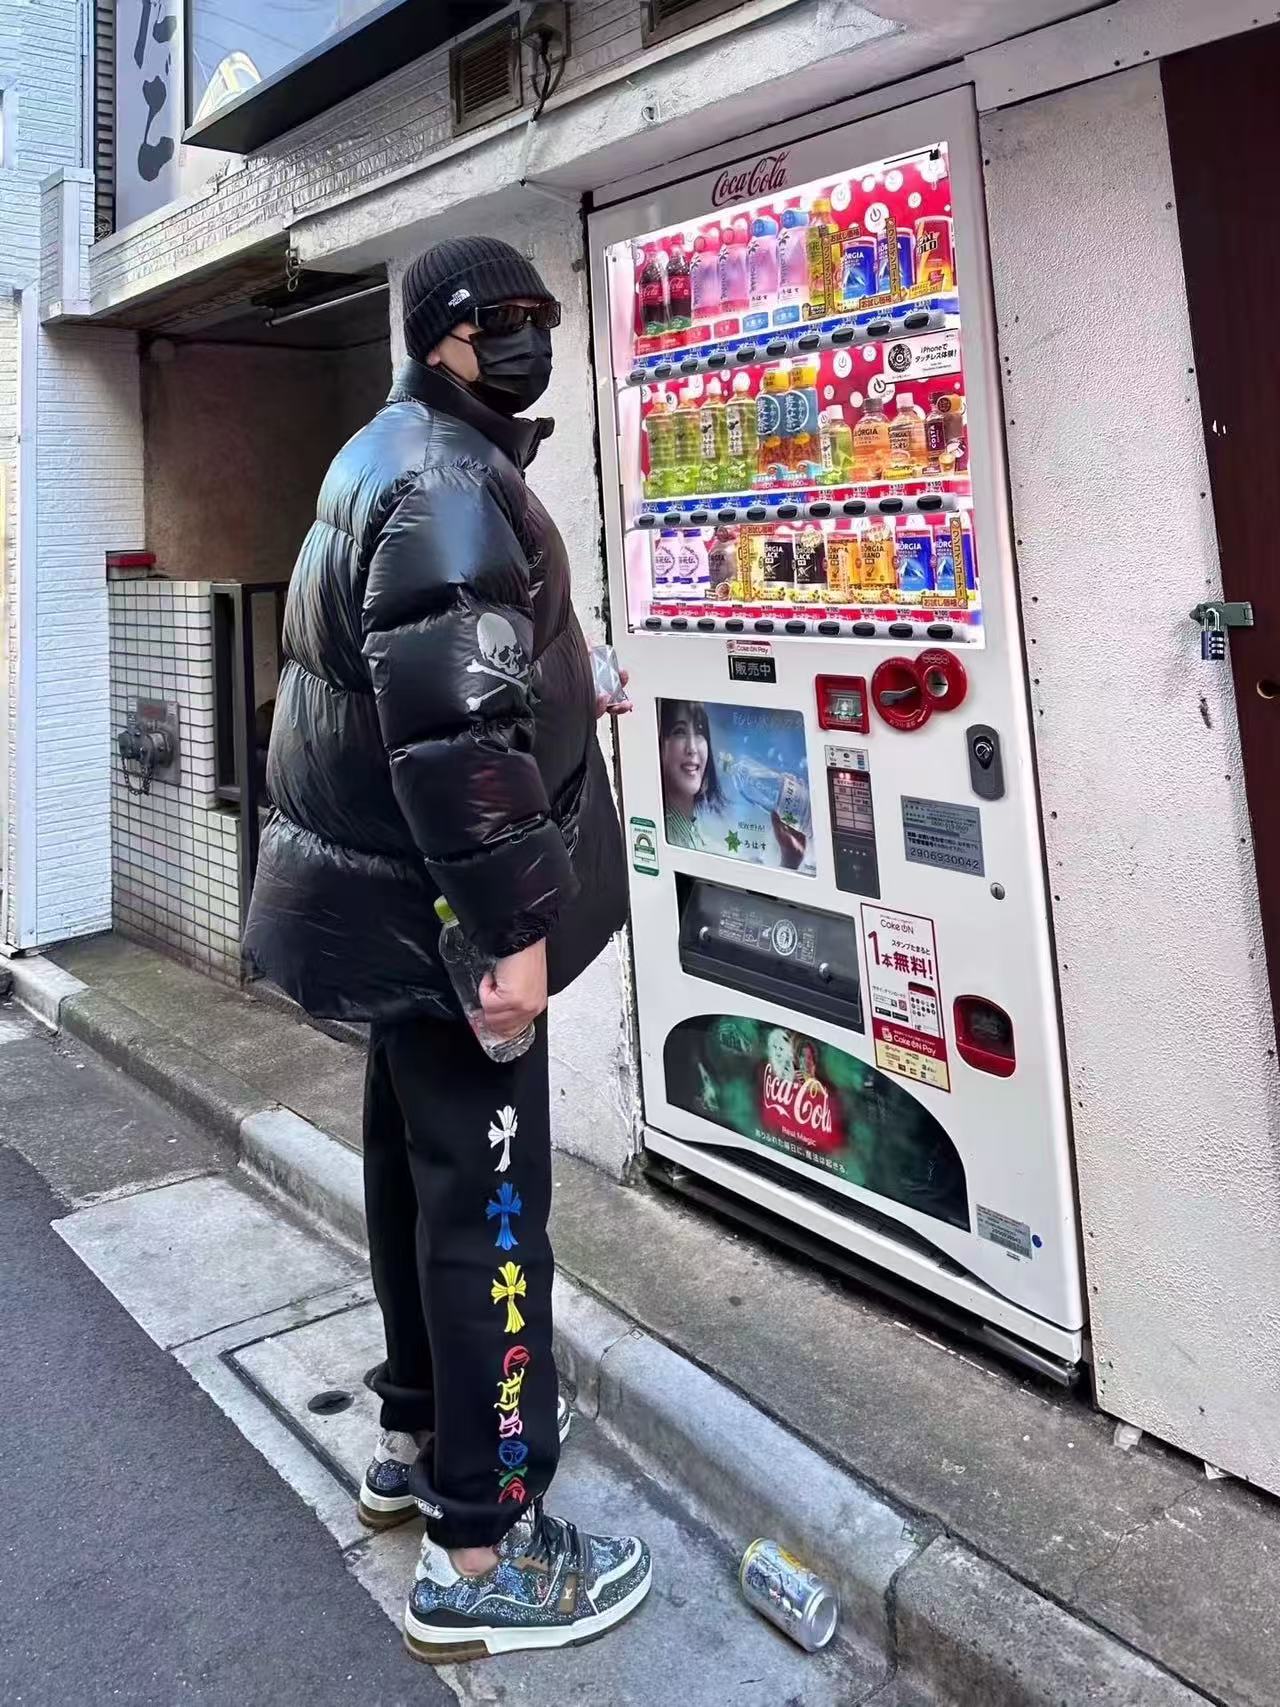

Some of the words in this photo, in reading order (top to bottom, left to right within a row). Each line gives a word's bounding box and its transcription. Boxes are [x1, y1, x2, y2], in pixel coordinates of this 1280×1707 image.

[712, 151, 790, 207] Coca-Cola
[921, 343, 948, 353] iPhoneで
[736, 661, 771, 677] 販売中
[880, 919, 900, 931] Coke
[891, 939, 931, 956] スタンプたまると
[893, 1035, 911, 1047] Coke
[922, 1044, 936, 1057] Pay
[763, 1063, 833, 1134] Coca-Cola
[782, 1125, 796, 1138] Real
[797, 1132, 817, 1147] Magic
